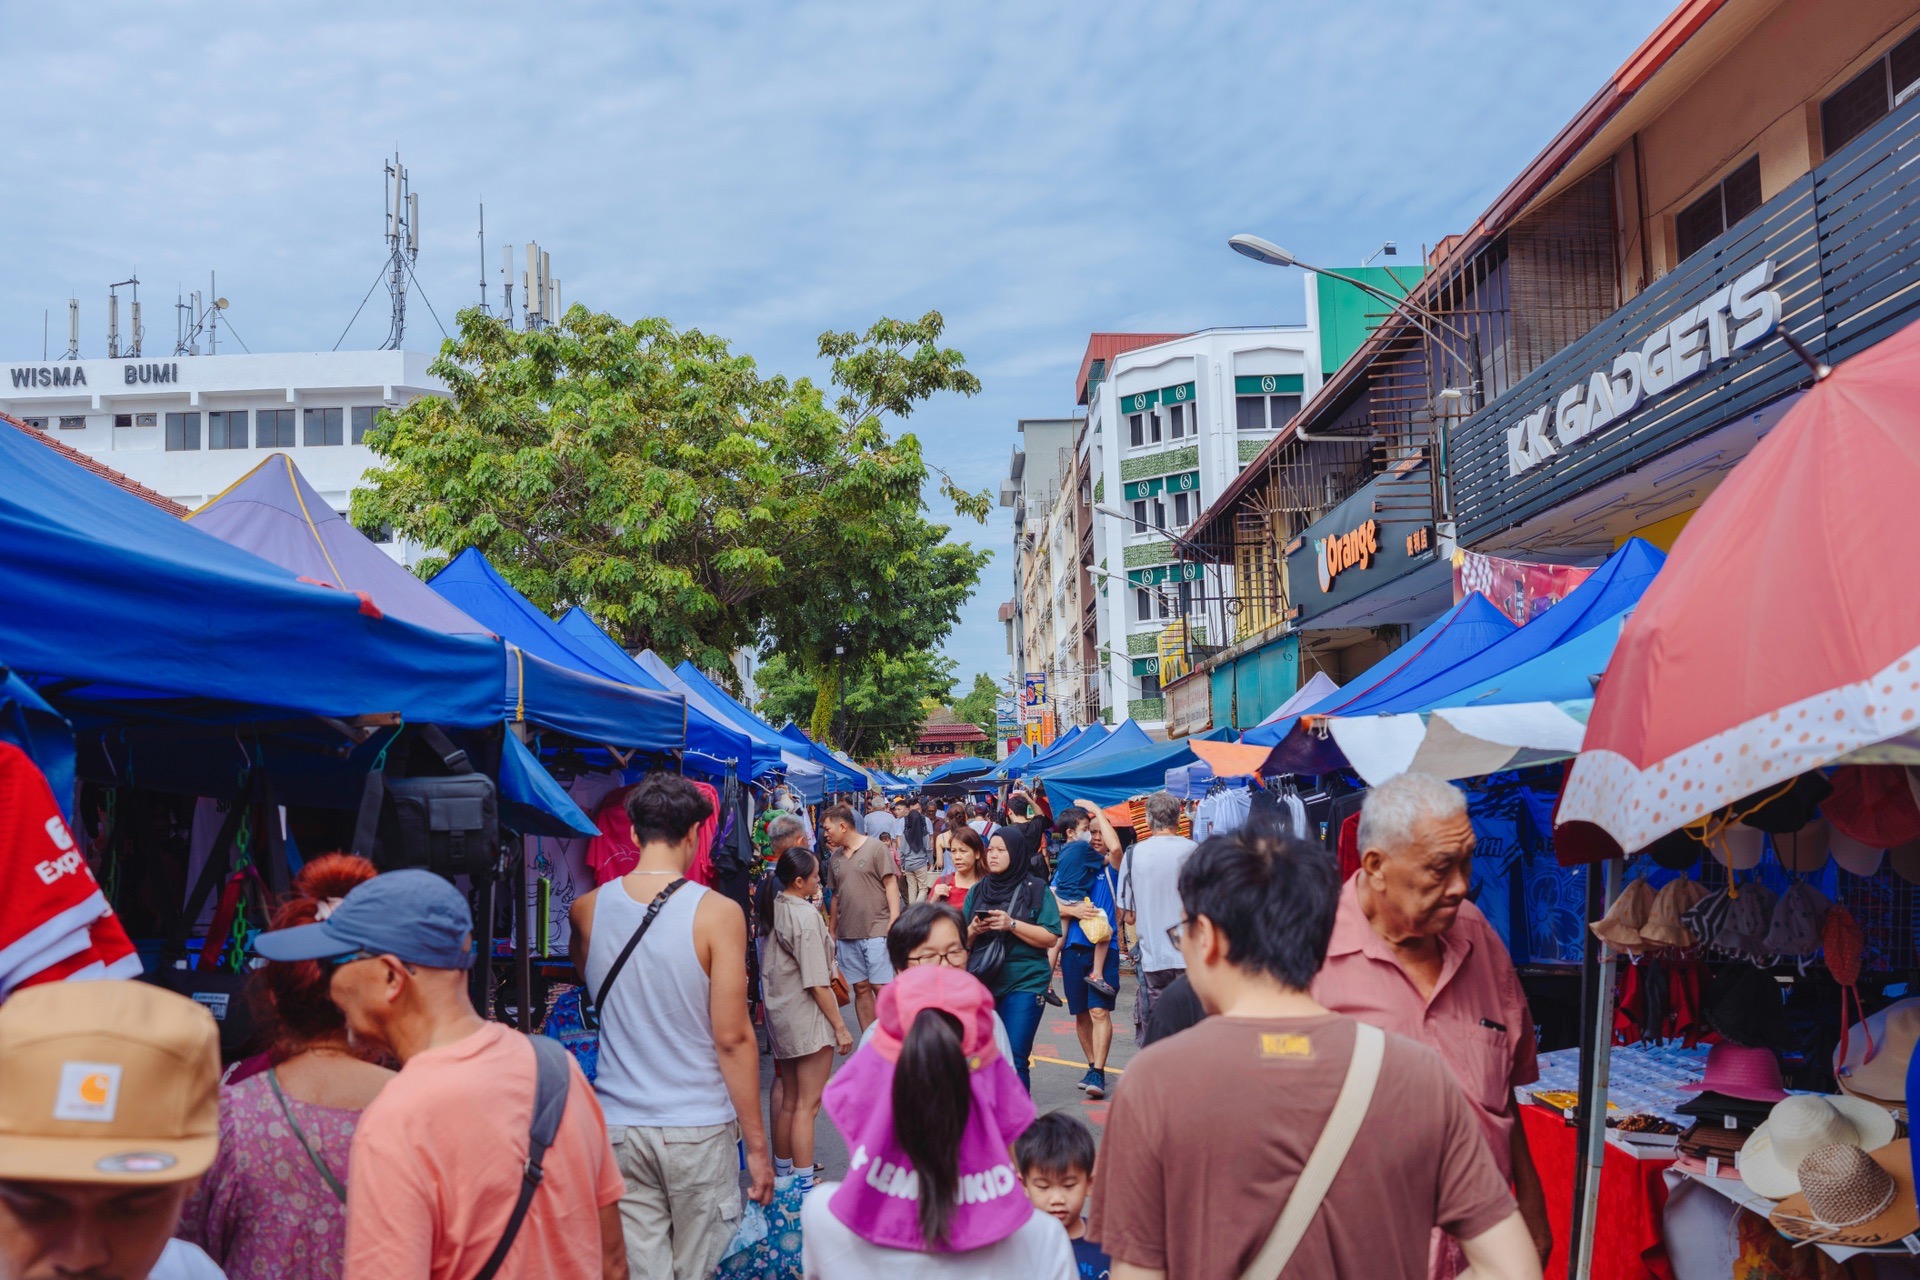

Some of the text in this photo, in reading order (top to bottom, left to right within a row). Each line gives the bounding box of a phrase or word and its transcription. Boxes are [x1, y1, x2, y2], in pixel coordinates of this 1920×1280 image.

[10, 363, 178, 389] WISMA BUMI
[1507, 260, 1782, 477] KK GADGETS
[1326, 518, 1378, 578] Orange
[865, 1156, 1016, 1206] LEMKID
